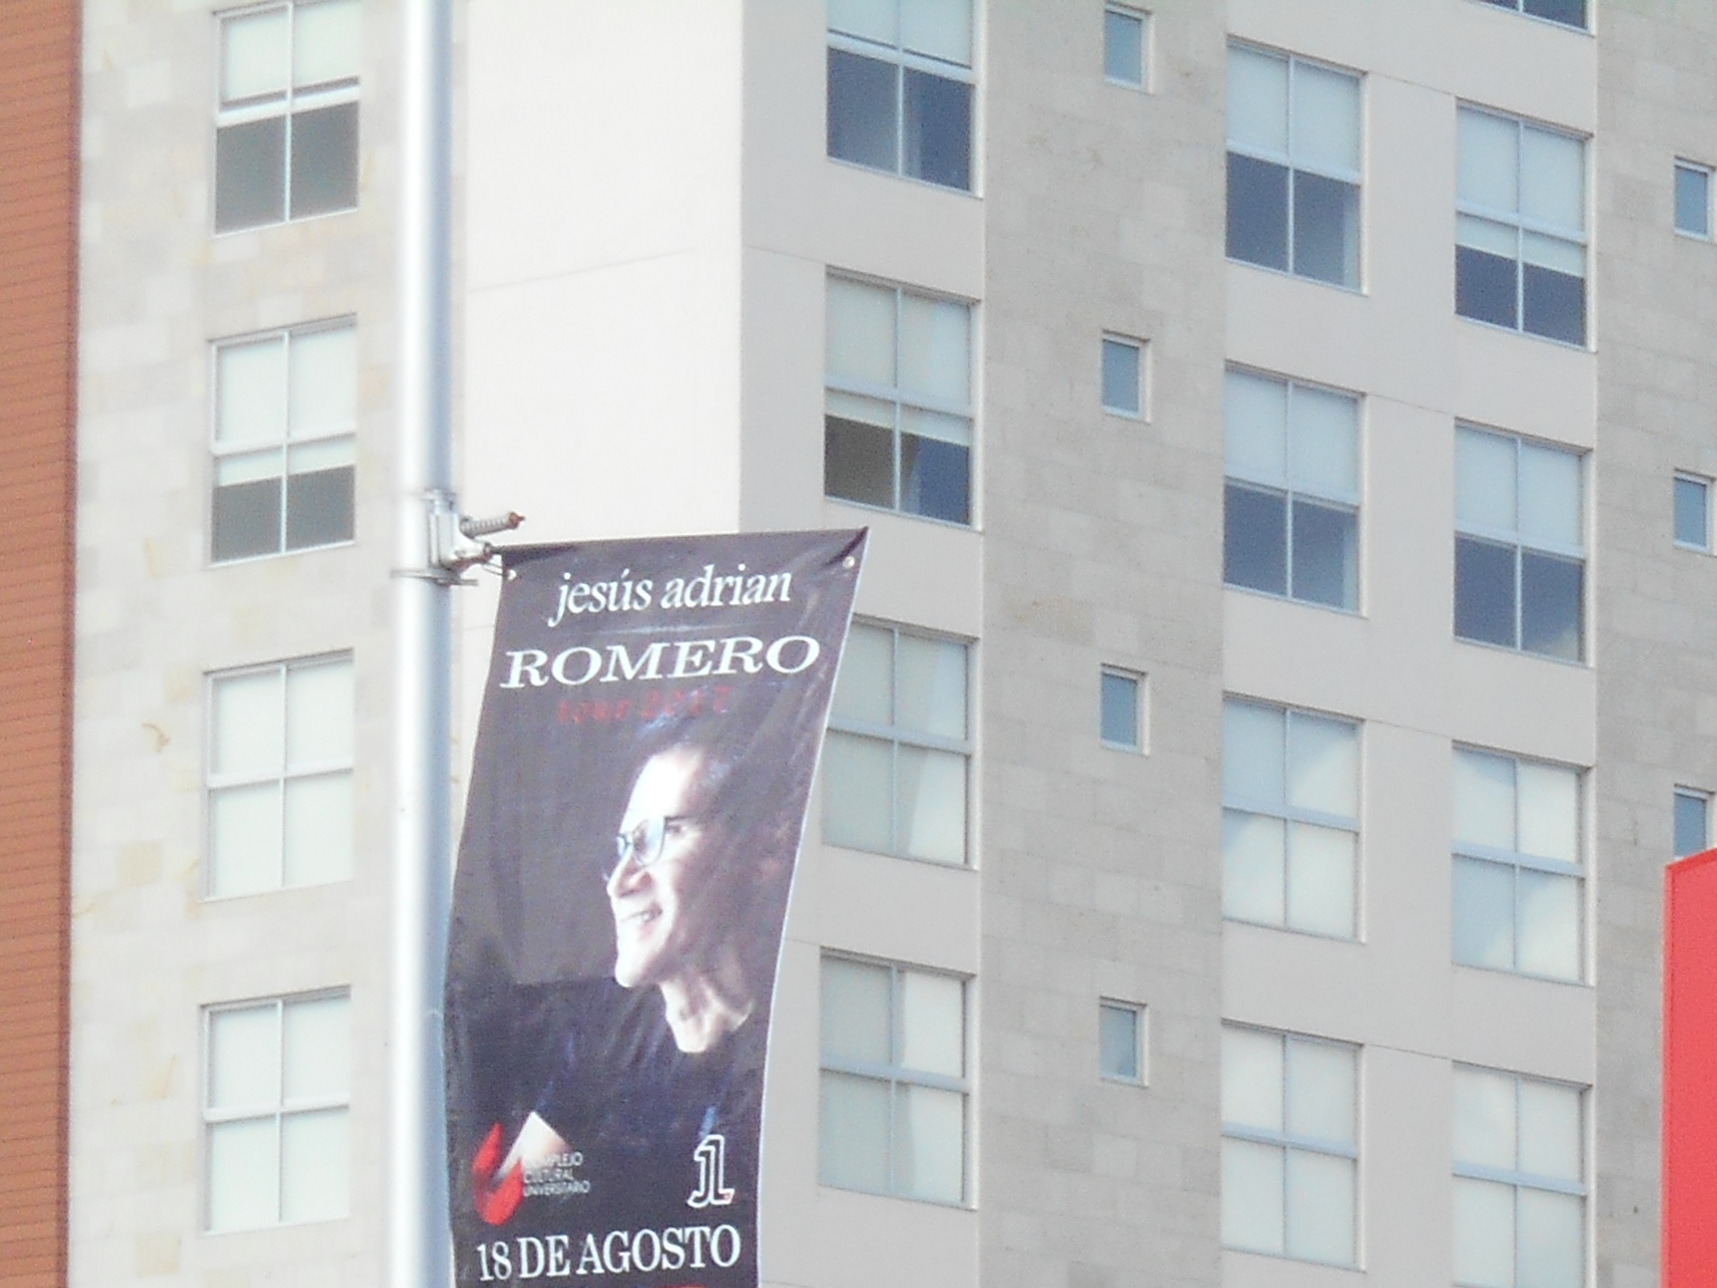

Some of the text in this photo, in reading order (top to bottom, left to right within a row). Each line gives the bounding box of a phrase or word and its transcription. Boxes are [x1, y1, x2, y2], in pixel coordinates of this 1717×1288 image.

[548, 564, 792, 627] jesús adrian
[500, 635, 820, 689] ROMERO
[477, 1224, 741, 1281] 18 DE AGOSTO
